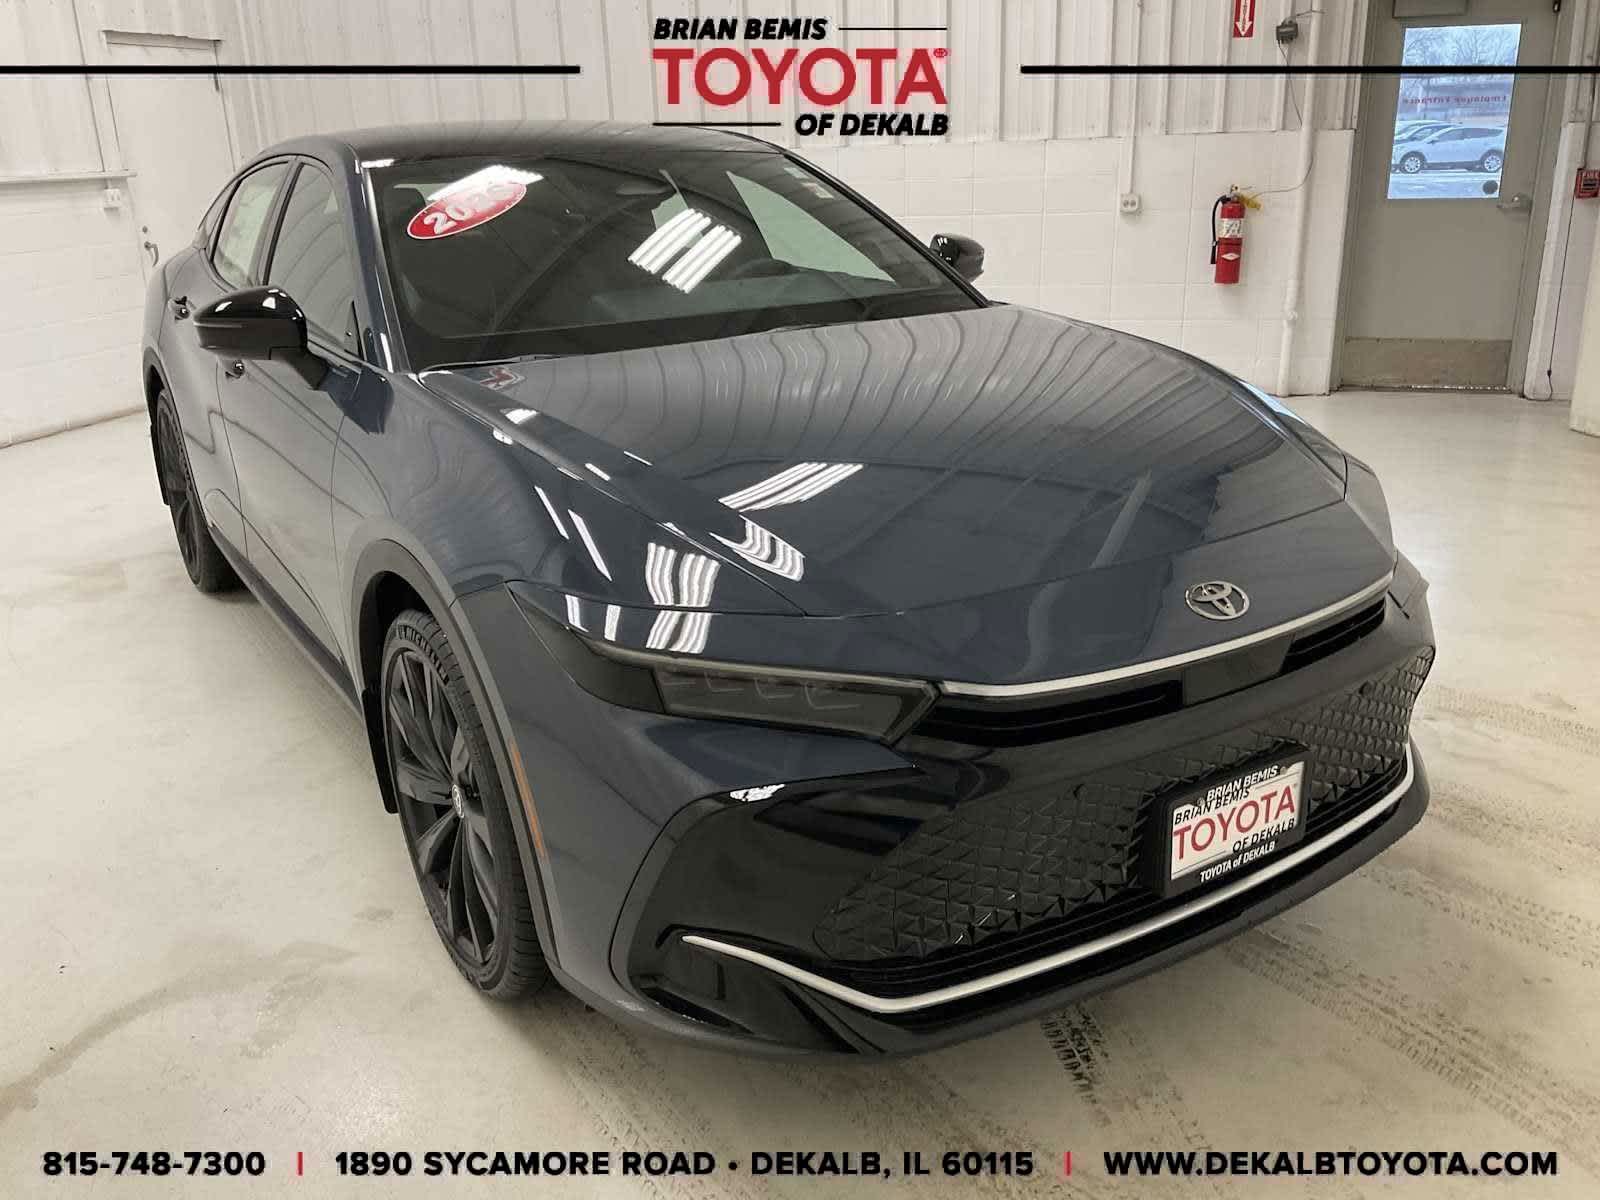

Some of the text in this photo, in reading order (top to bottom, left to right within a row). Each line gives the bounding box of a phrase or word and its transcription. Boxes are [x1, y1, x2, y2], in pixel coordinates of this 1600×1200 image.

[1207, 765, 1279, 801] BRIAN BEMIS
[1173, 785, 1296, 860] TOYOTA
[1174, 787, 1250, 825] BRIAN BEMIS
[1232, 818, 1295, 854] OF DEKALB
[1200, 841, 1276, 882] TOYOTA of DEKALB
